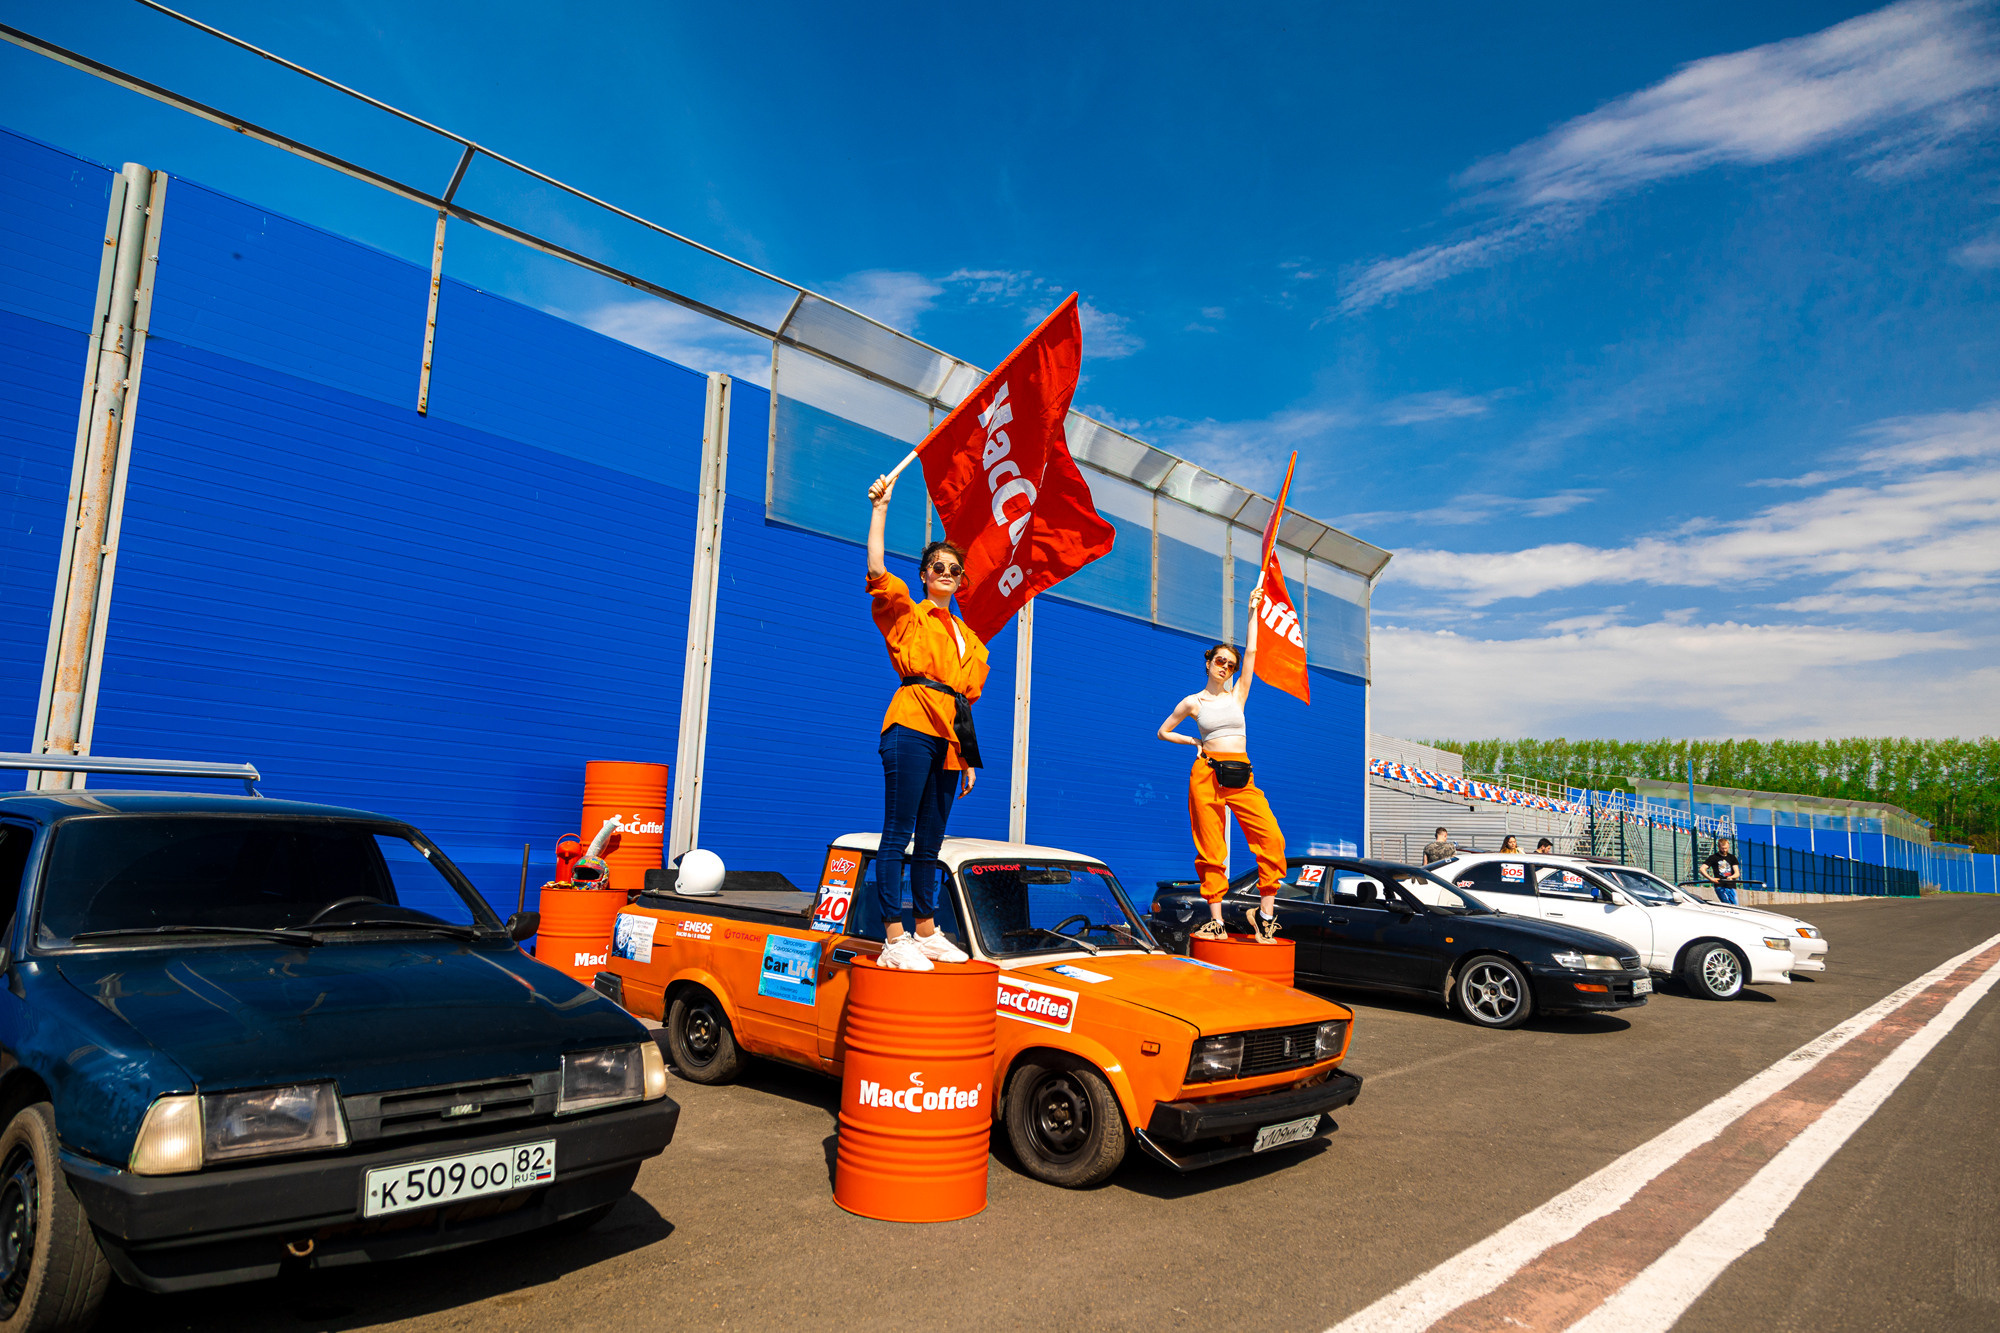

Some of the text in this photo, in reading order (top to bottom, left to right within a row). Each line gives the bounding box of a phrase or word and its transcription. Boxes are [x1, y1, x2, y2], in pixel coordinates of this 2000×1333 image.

[831, 858, 856, 875] WET
[1502, 868, 1523, 876] 505
[1299, 869, 1322, 881] 12
[815, 896, 848, 921] 40
[683, 920, 713, 934] ENEOS
[731, 931, 762, 942] TOTACHI
[859, 1079, 979, 1113] MacCoffee
[516, 1147, 545, 1172] 82
[514, 1171, 537, 1184] RUS
